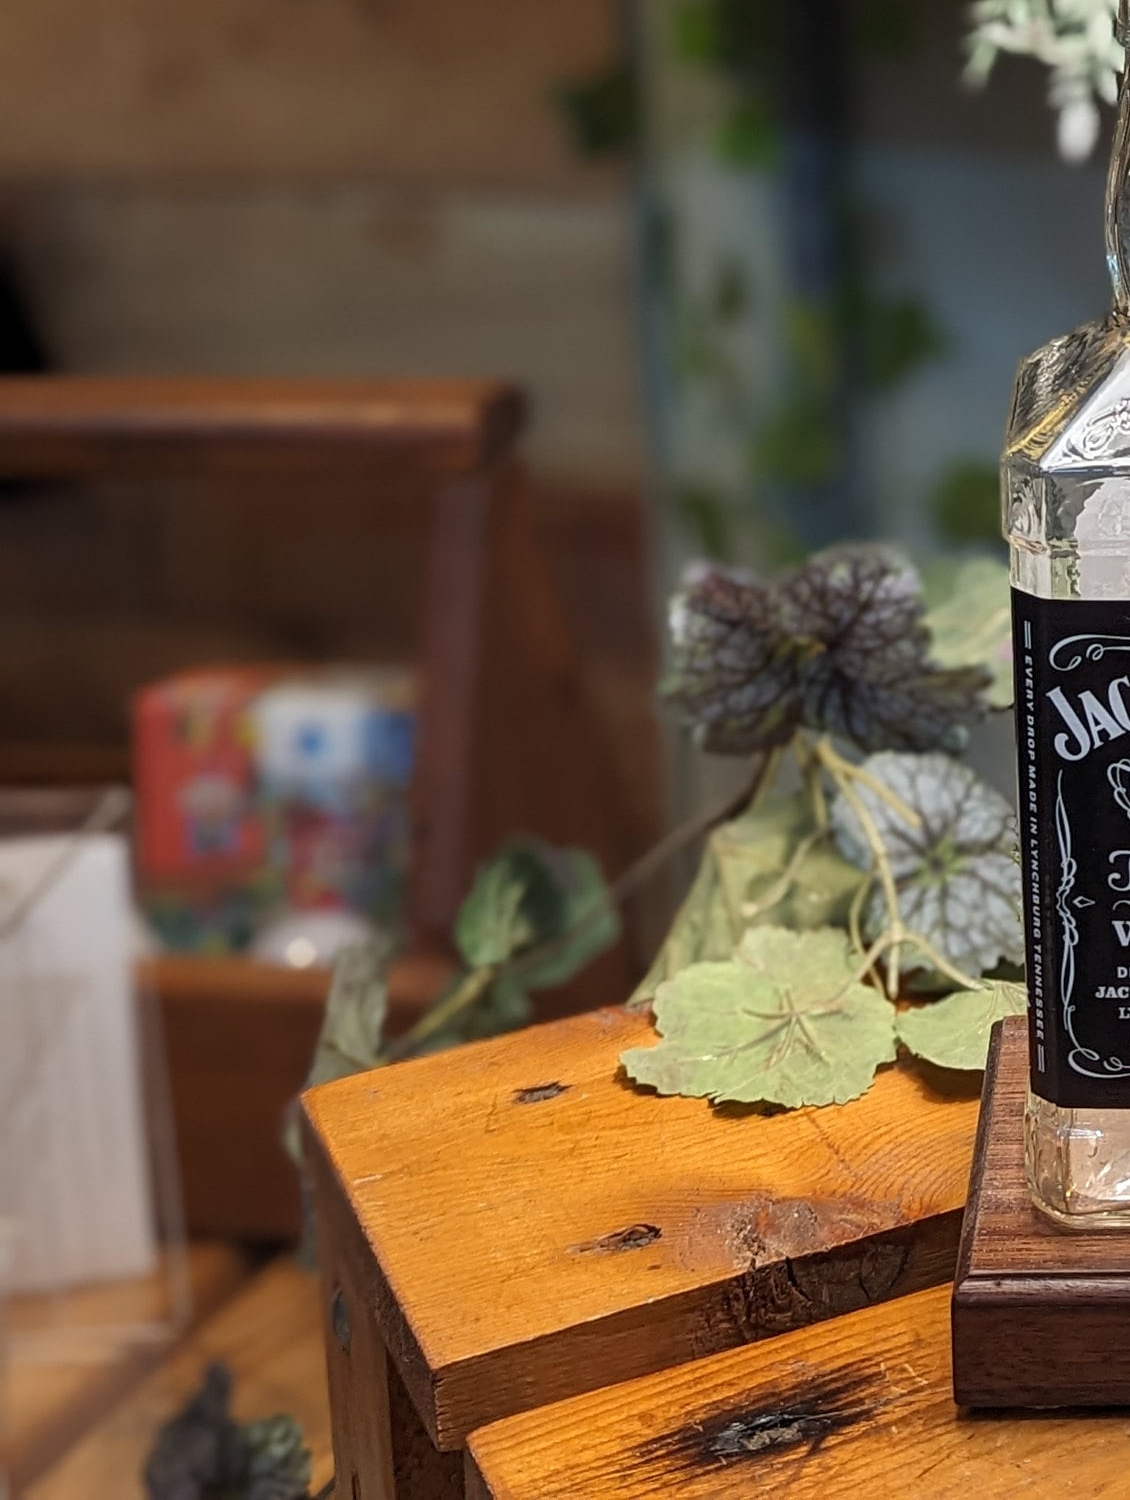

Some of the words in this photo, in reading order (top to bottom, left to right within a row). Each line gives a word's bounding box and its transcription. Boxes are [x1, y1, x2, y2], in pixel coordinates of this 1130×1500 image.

[1025, 655, 1034, 712] EVERY
[1027, 716, 1036, 761] DROP
[1028, 765, 1037, 814] MADE
[1030, 816, 1038, 834] IN
[1031, 837, 1041, 939] LYNCHBURG
[1033, 943, 1045, 1040] TENNESSEE
